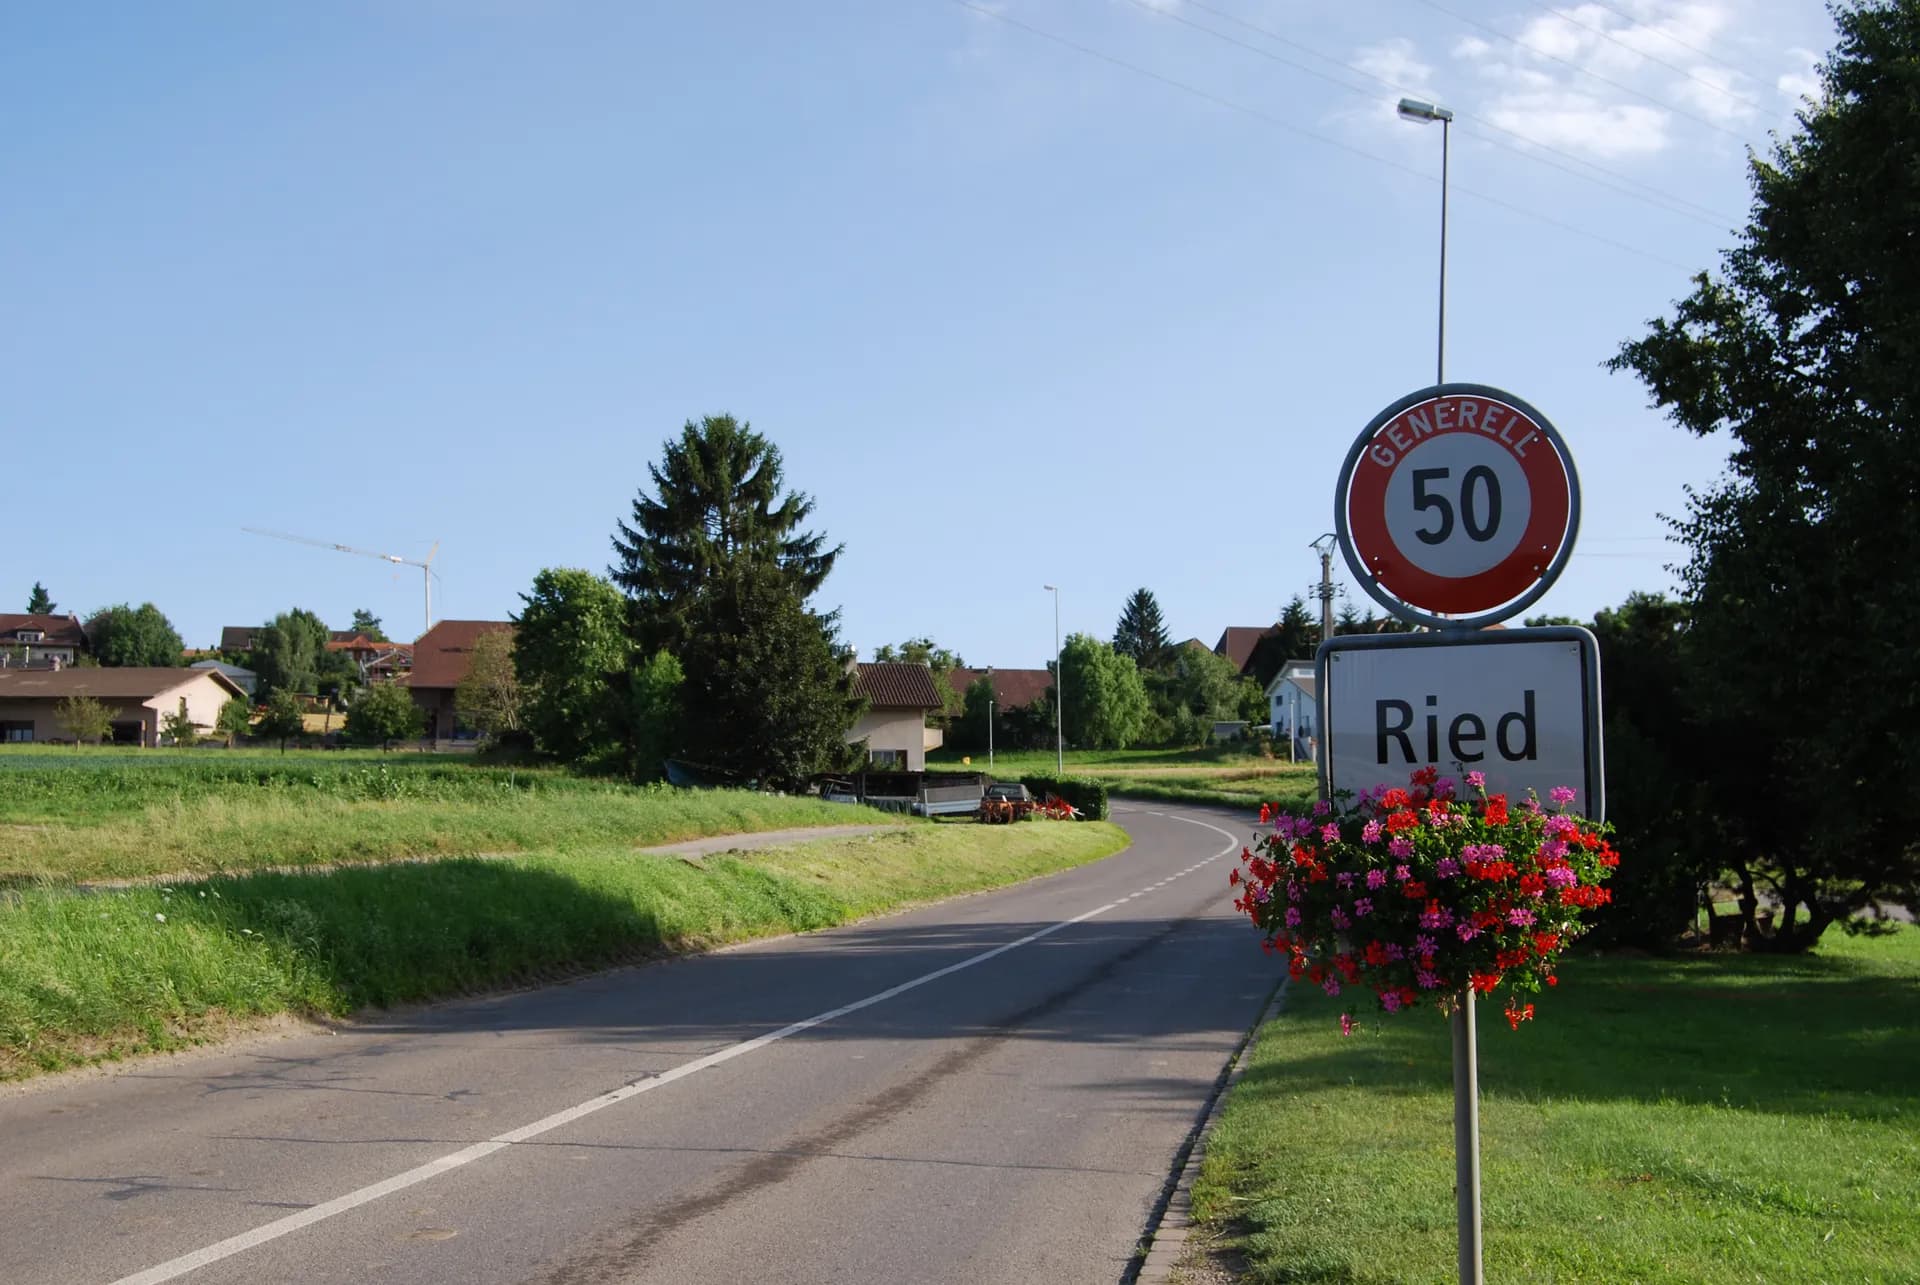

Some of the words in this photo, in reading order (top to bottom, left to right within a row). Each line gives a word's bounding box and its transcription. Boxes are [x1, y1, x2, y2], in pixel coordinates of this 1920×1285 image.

[1370, 400, 1536, 467] GENERELL
[1412, 465, 1502, 545] 50
[1376, 690, 1537, 764] Ried
